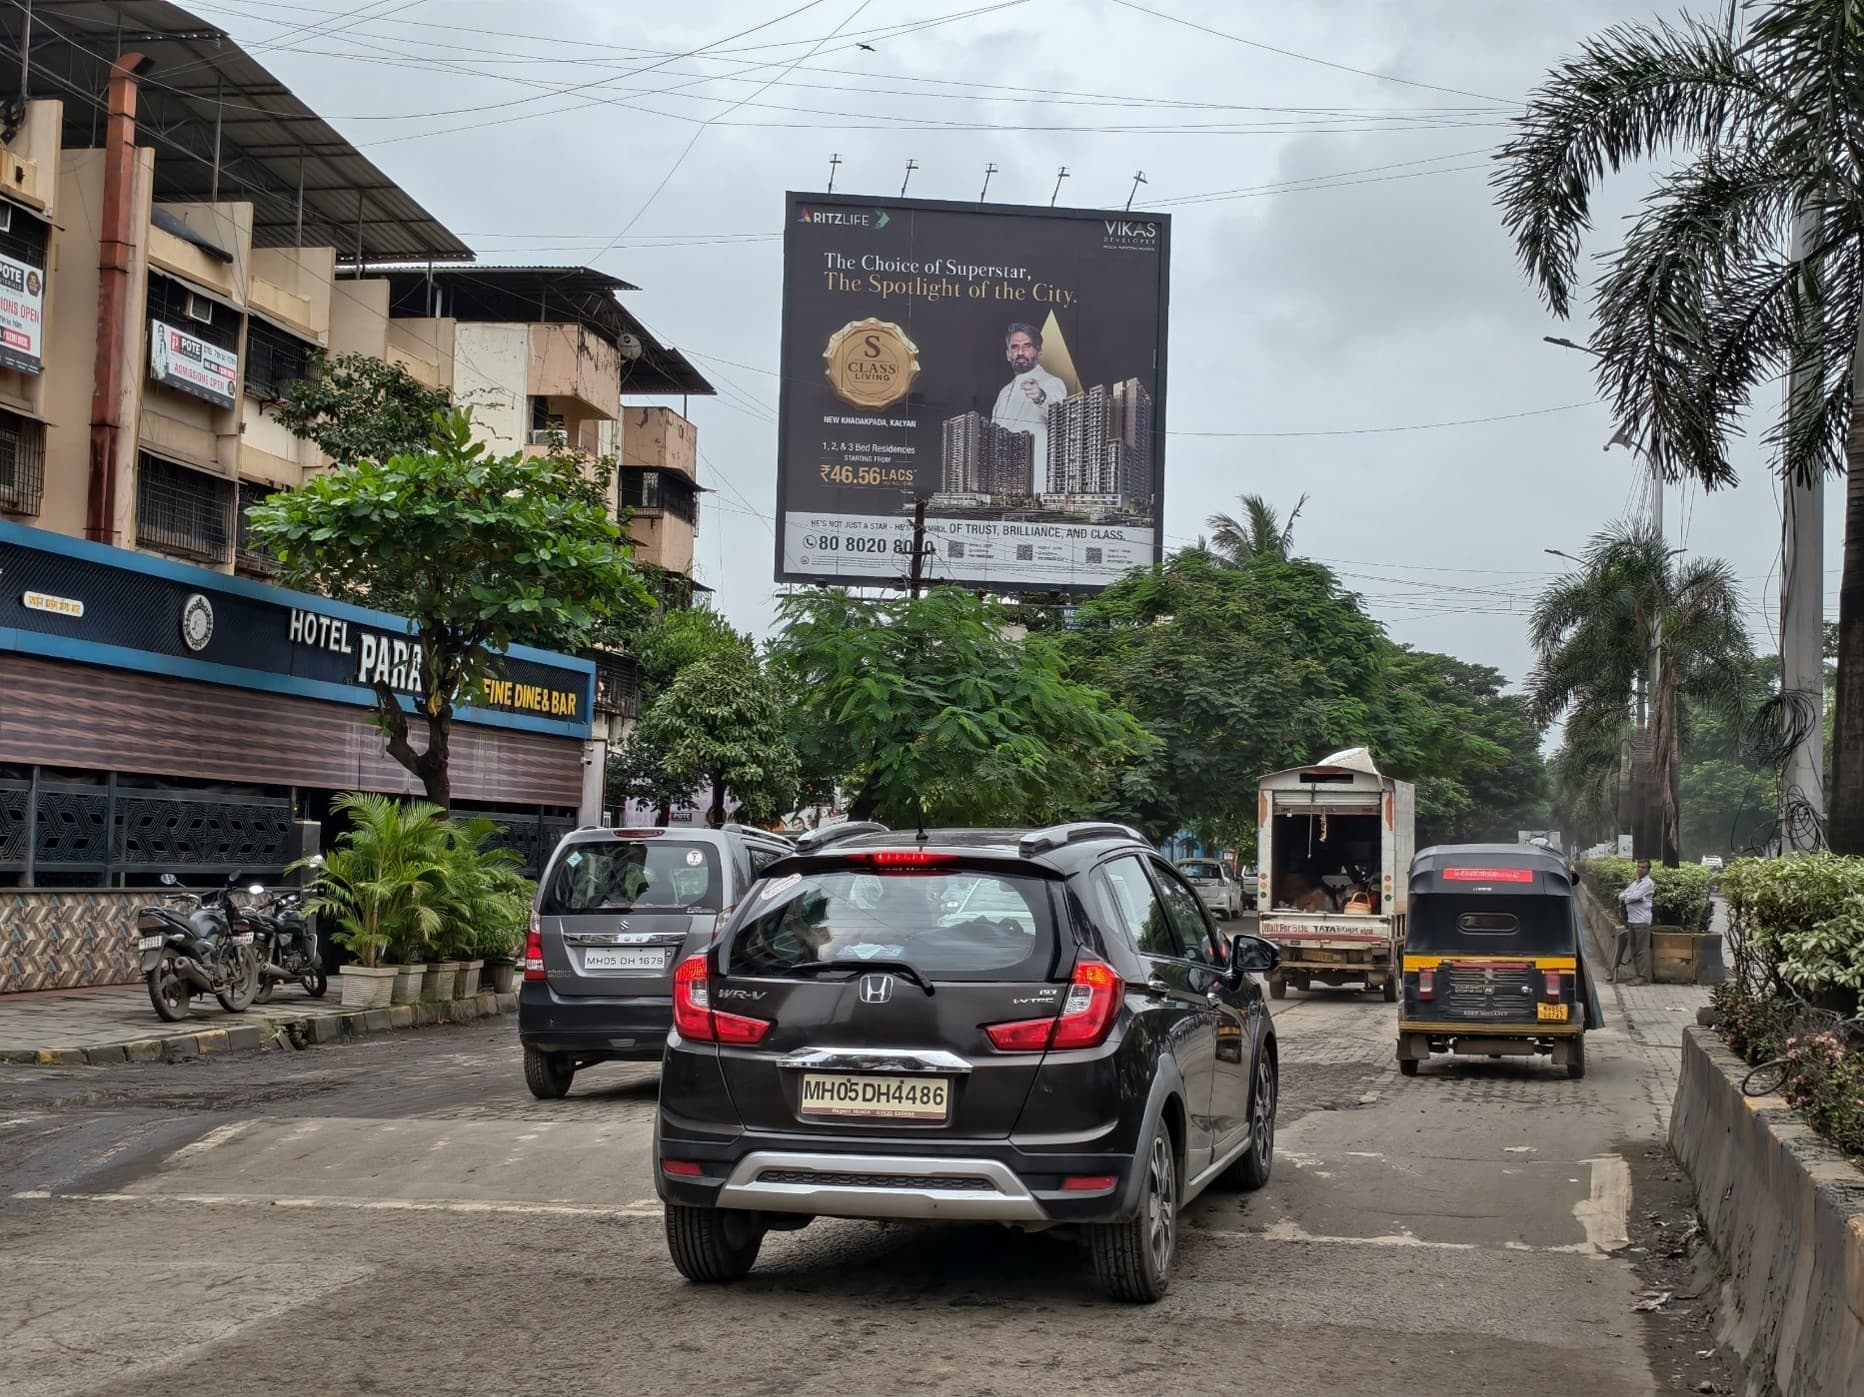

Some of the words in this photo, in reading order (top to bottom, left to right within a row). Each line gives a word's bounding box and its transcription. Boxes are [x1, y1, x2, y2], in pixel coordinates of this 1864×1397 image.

[1105, 220, 1156, 237] VIKAS
[824, 252, 856, 270] The
[861, 254, 919, 273] Choice
[925, 259, 943, 274] of
[946, 259, 1032, 281] Superstar,
[824, 271, 862, 292] The
[868, 273, 961, 301] Spotlight
[968, 281, 990, 299] of
[995, 282, 1025, 300] the
[1032, 282, 1078, 309] City.
[21, 304, 40, 324] OPEN
[181, 338, 201, 355] POTE
[864, 335, 881, 358] S
[848, 361, 896, 375] CLASS
[855, 373, 890, 381] LIVING
[823, 415, 840, 424] NEW
[889, 419, 917, 428] KALYAN
[840, 442, 847, 451] &
[848, 443, 854, 452] 3
[855, 443, 870, 452] Bed
[871, 443, 916, 454] Residences
[828, 520, 844, 529] NOT
[844, 521, 863, 529] JUST
[863, 522, 869, 530] A
[869, 522, 888, 531] STAR
[949, 523, 963, 534] OF
[966, 524, 1000, 537] TRUST,
[1002, 525, 1065, 540] BRILLIANCE,
[1066, 528, 1087, 539] AND
[1090, 529, 1126, 541] CLASS.
[819, 535, 839, 551] 80
[846, 537, 887, 553] 8020
[893, 539, 934, 554] 800
[289, 607, 351, 655] HOTEL
[483, 678, 513, 706] FINE
[551, 690, 577, 716] BAR
[1312, 925, 1336, 934] TATA
[586, 957, 617, 966] MH05
[620, 958, 636, 966] DH
[639, 957, 664, 966] 1679
[718, 988, 769, 1001] WR-V
